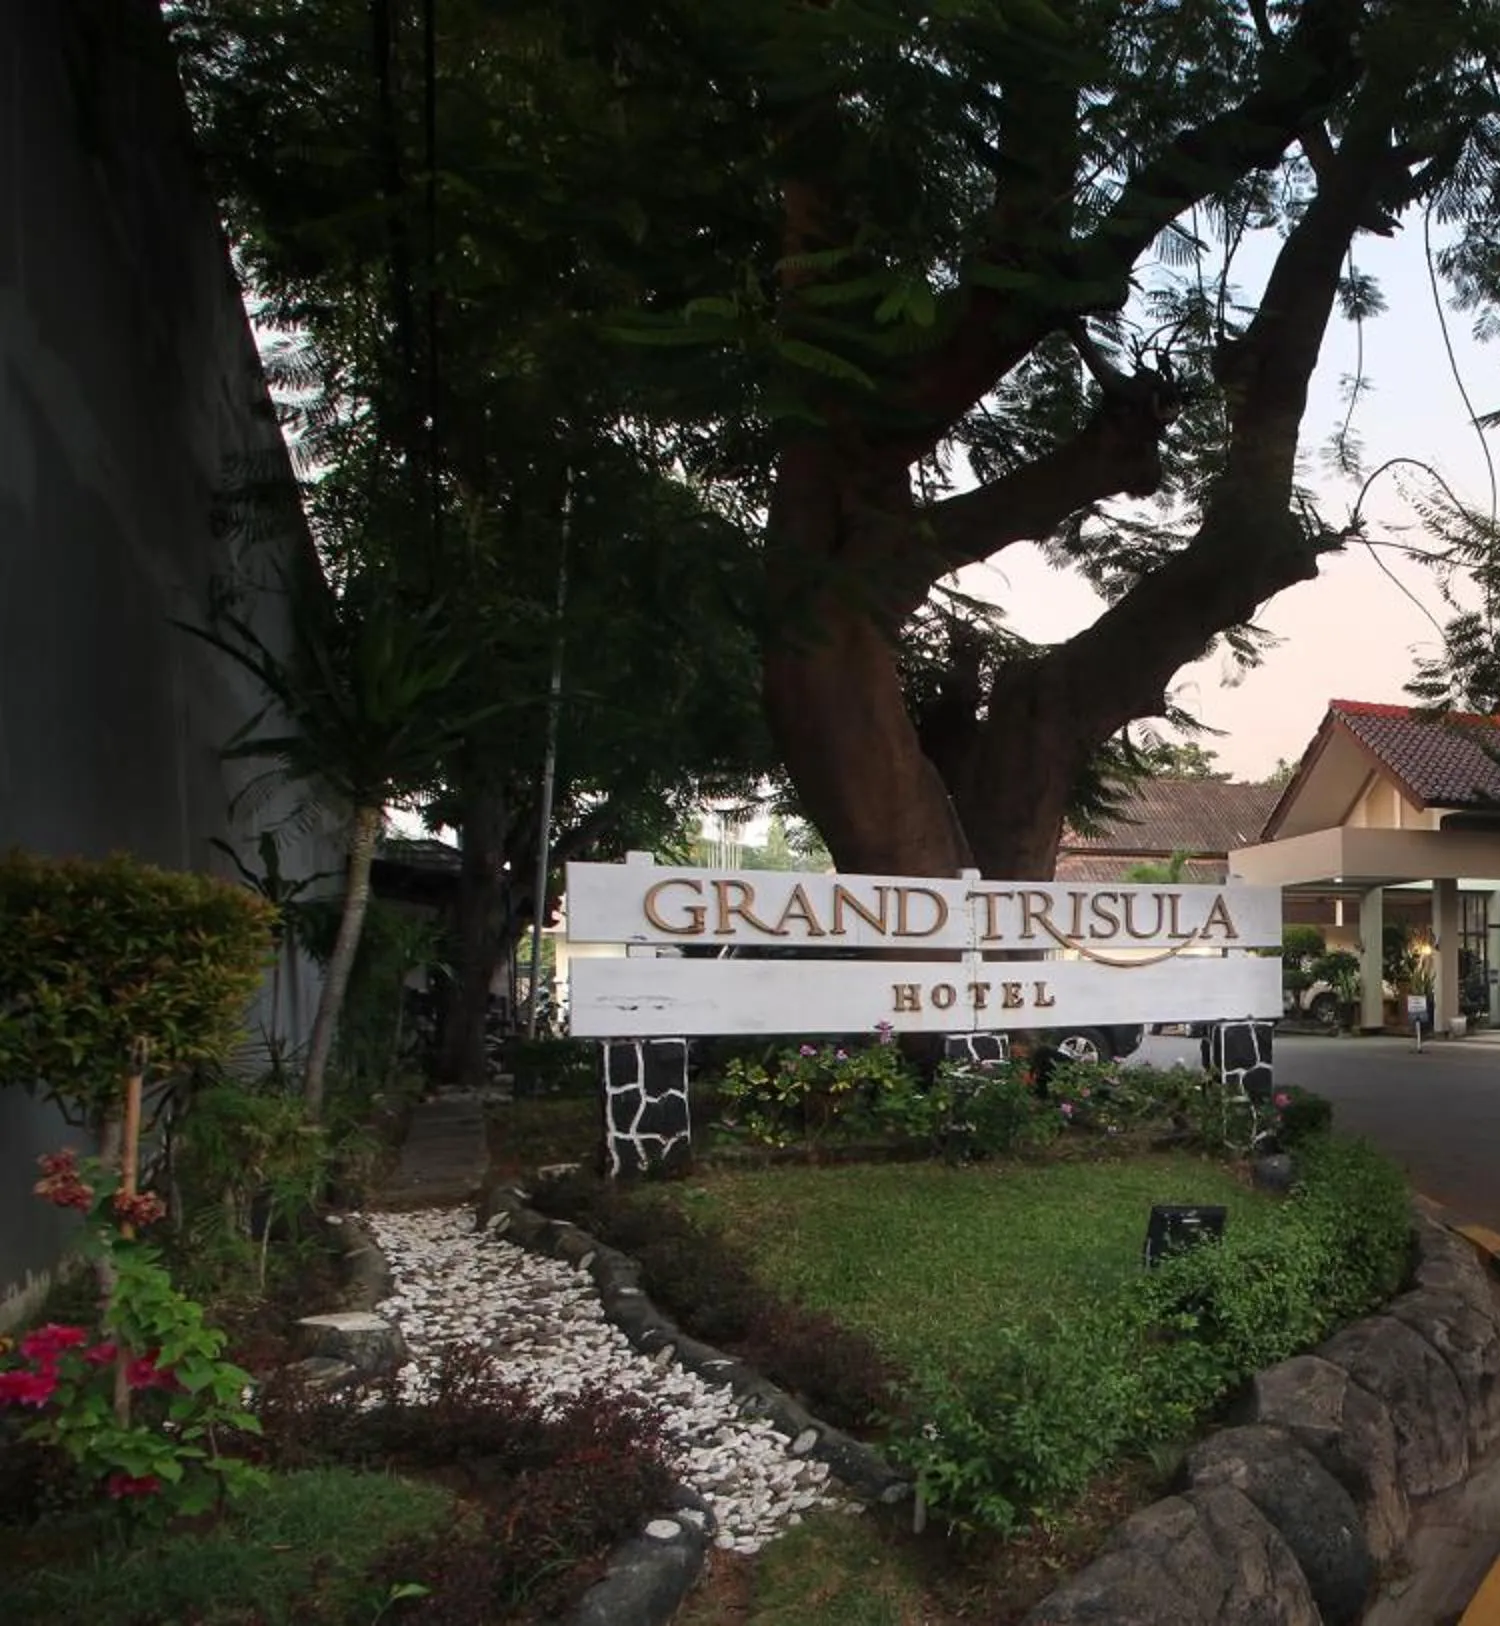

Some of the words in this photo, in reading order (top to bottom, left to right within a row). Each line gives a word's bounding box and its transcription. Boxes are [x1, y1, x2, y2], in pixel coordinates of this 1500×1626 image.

[645, 878, 948, 936] GRAND
[966, 890, 1239, 967] TRISULA
[892, 981, 1056, 1012] HOTEL
